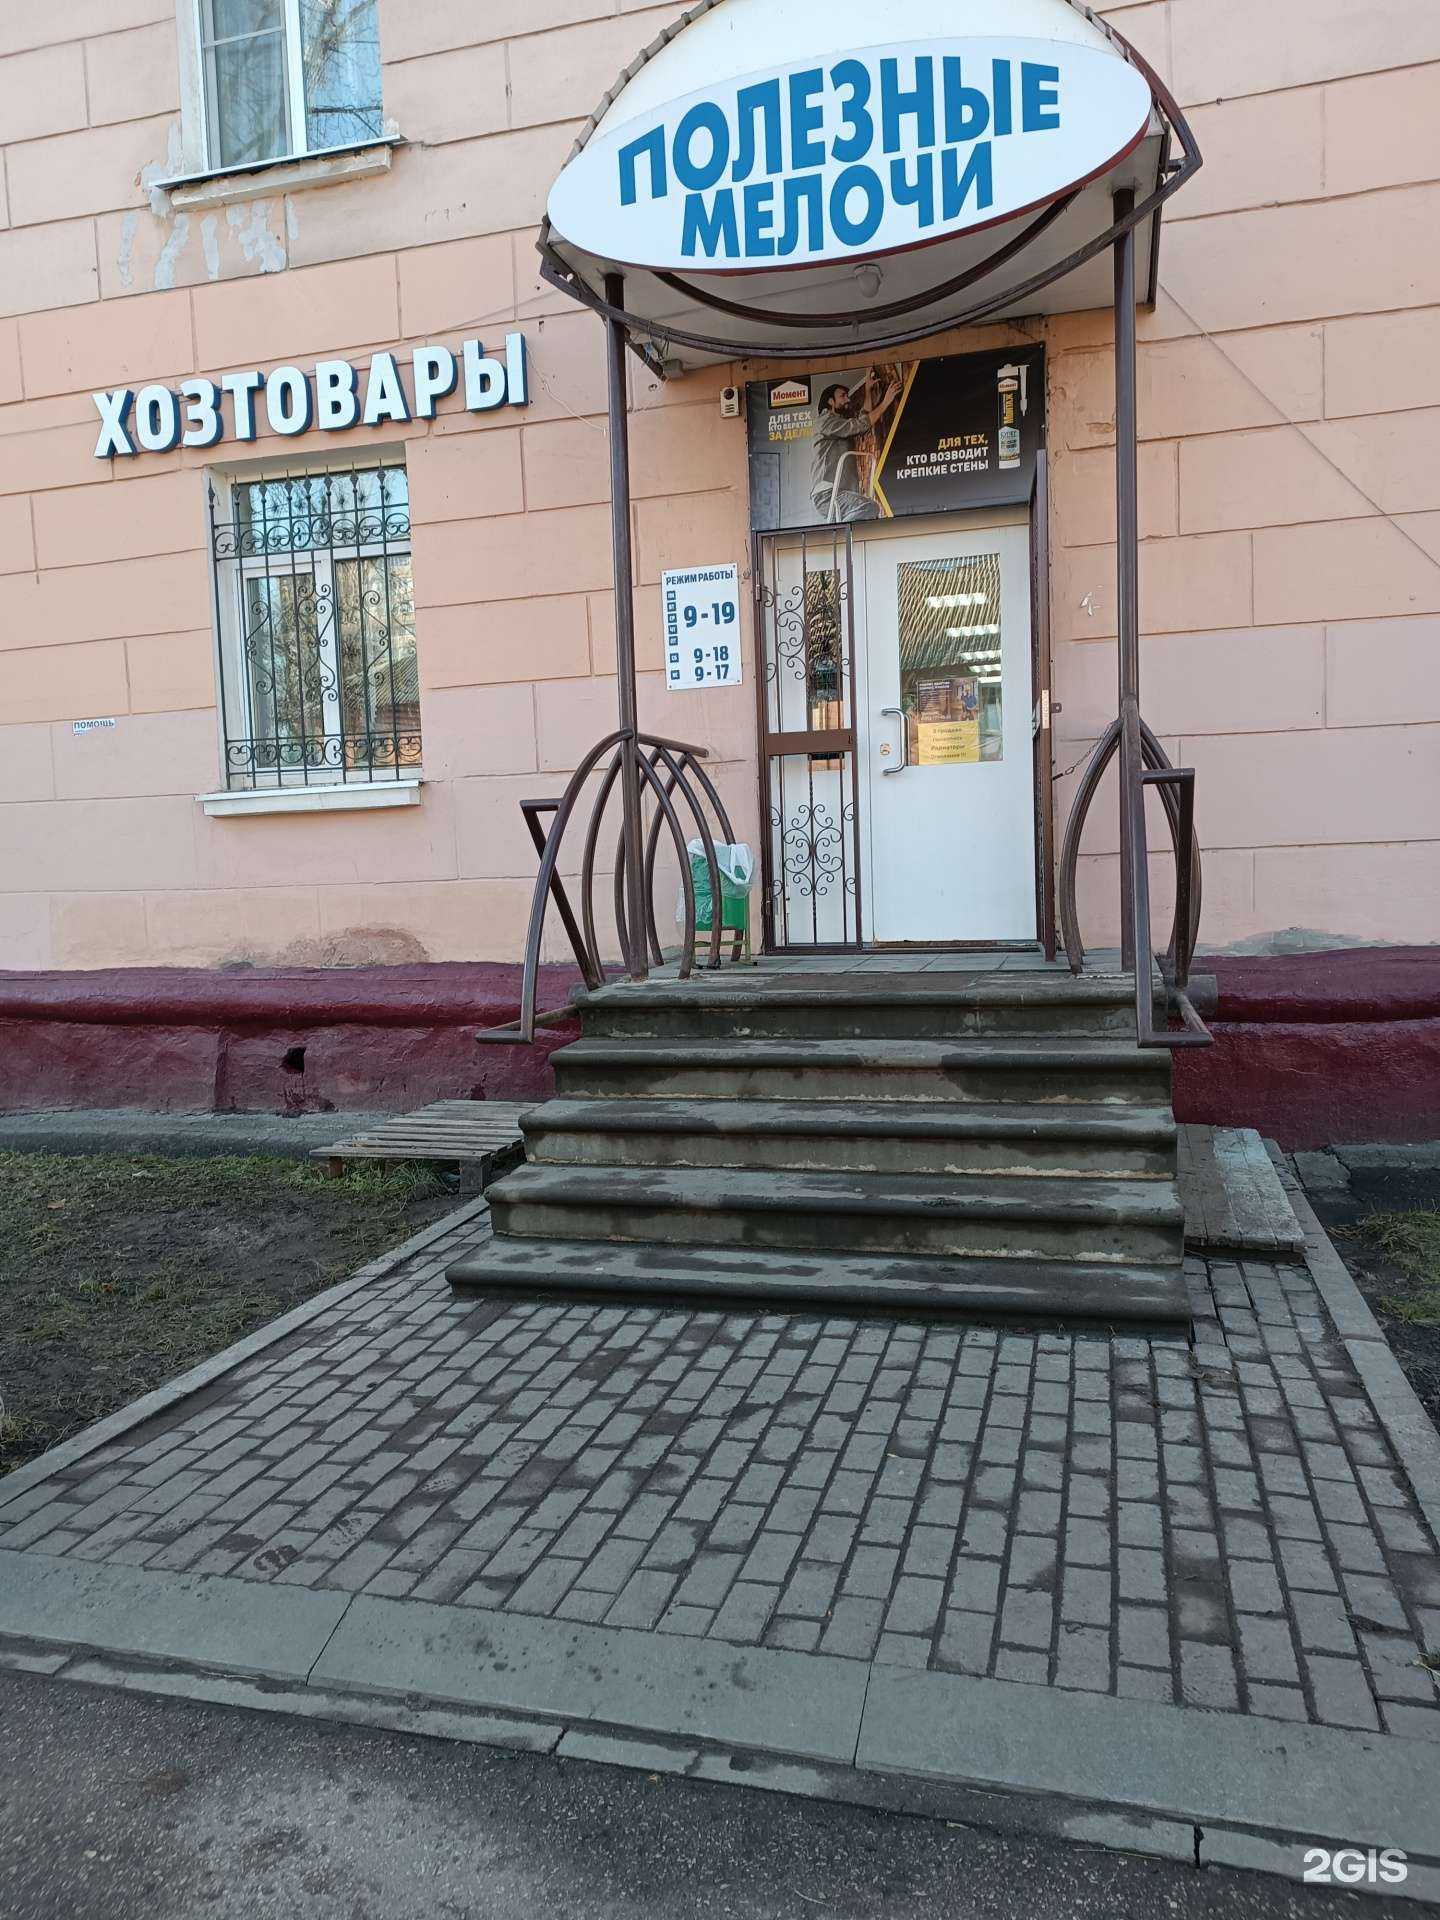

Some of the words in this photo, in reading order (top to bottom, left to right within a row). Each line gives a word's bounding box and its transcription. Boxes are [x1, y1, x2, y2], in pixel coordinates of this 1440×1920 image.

[618, 55, 1061, 206] ПОЛЕЗНЫЕ
[681, 140, 994, 258] МЕЛОЧИ
[92, 332, 529, 459] ХОЗТОВАРЫ
[772, 389, 807, 401] Момент
[769, 413, 791, 424] ДЛЯ
[768, 431, 783, 441] ЗА
[938, 436, 962, 450] ДЛЯ
[963, 433, 989, 445] ТЕХ,
[906, 454, 928, 466] КТО
[930, 446, 989, 462] ВОЗВОДИТ
[896, 464, 948, 480] КРЕПКИЕ
[950, 459, 989, 473] СТЕНЫ
[666, 574, 697, 586] РЕЖИМ
[698, 570, 733, 582] РАБОТЫ
